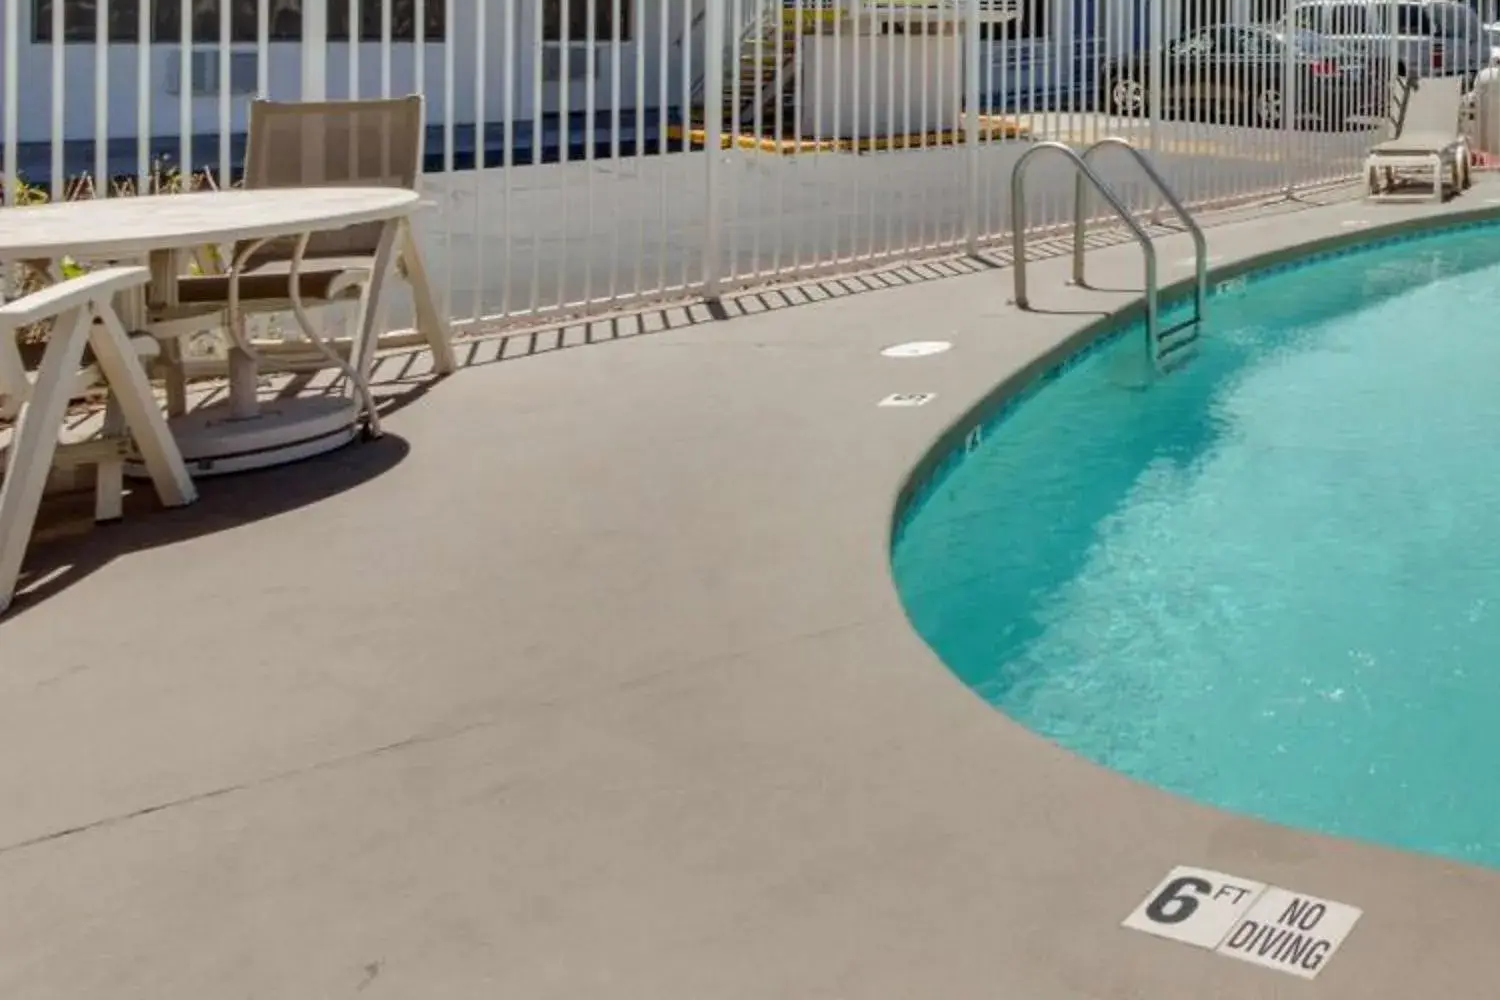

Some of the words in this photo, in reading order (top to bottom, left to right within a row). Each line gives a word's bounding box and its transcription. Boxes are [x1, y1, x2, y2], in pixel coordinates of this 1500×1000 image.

[1146, 876, 1212, 924] 6
[1213, 884, 1250, 905] FT
[1278, 898, 1327, 931] NO
[1228, 920, 1331, 970] DIVING
